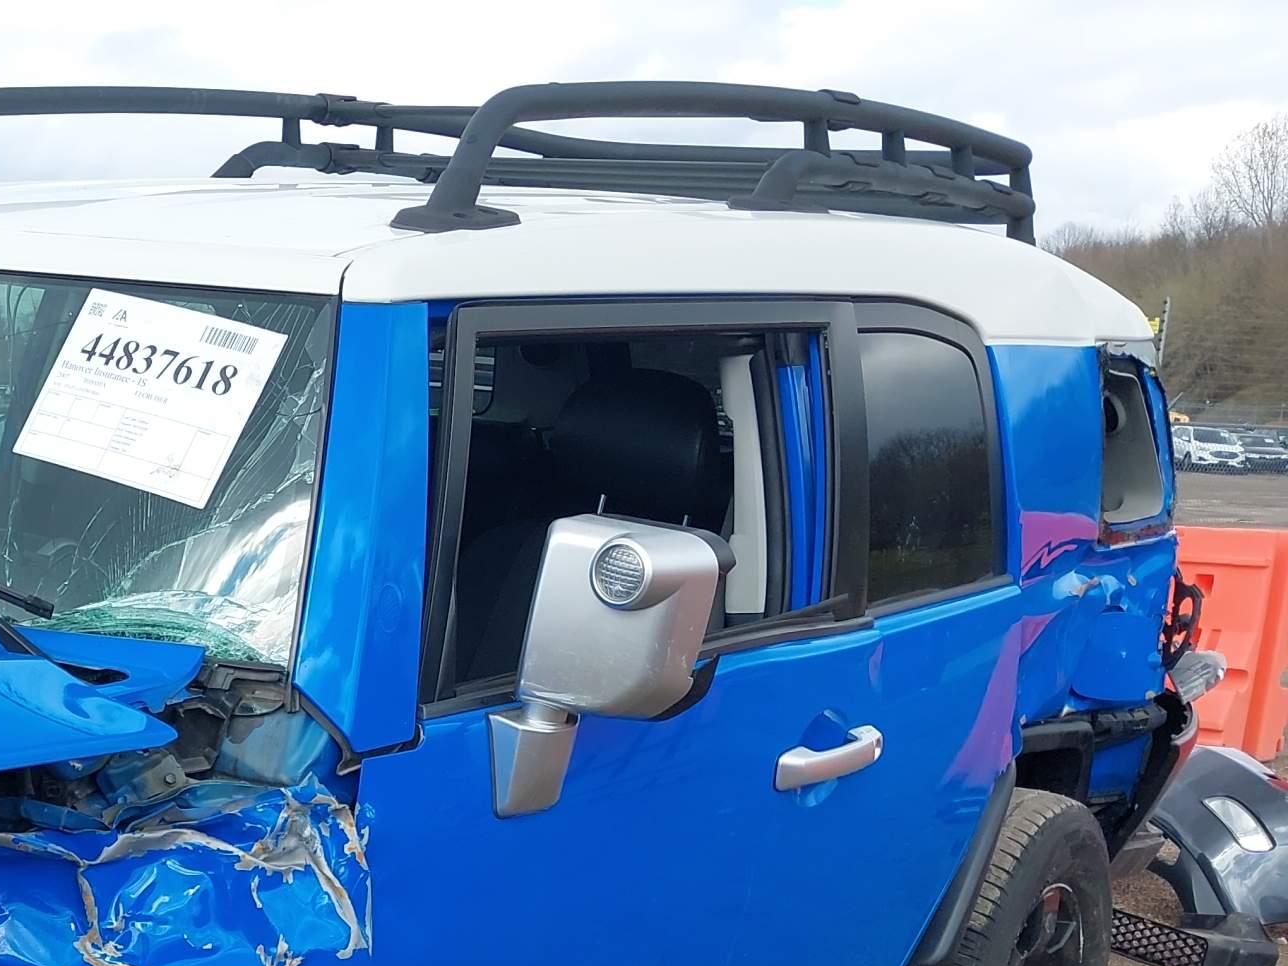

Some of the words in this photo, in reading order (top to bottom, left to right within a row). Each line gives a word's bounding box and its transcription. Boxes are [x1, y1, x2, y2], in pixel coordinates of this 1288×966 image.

[61, 360, 94, 375] Hanover
[94, 368, 131, 384] Insurance
[80, 333, 238, 396] 44837618
